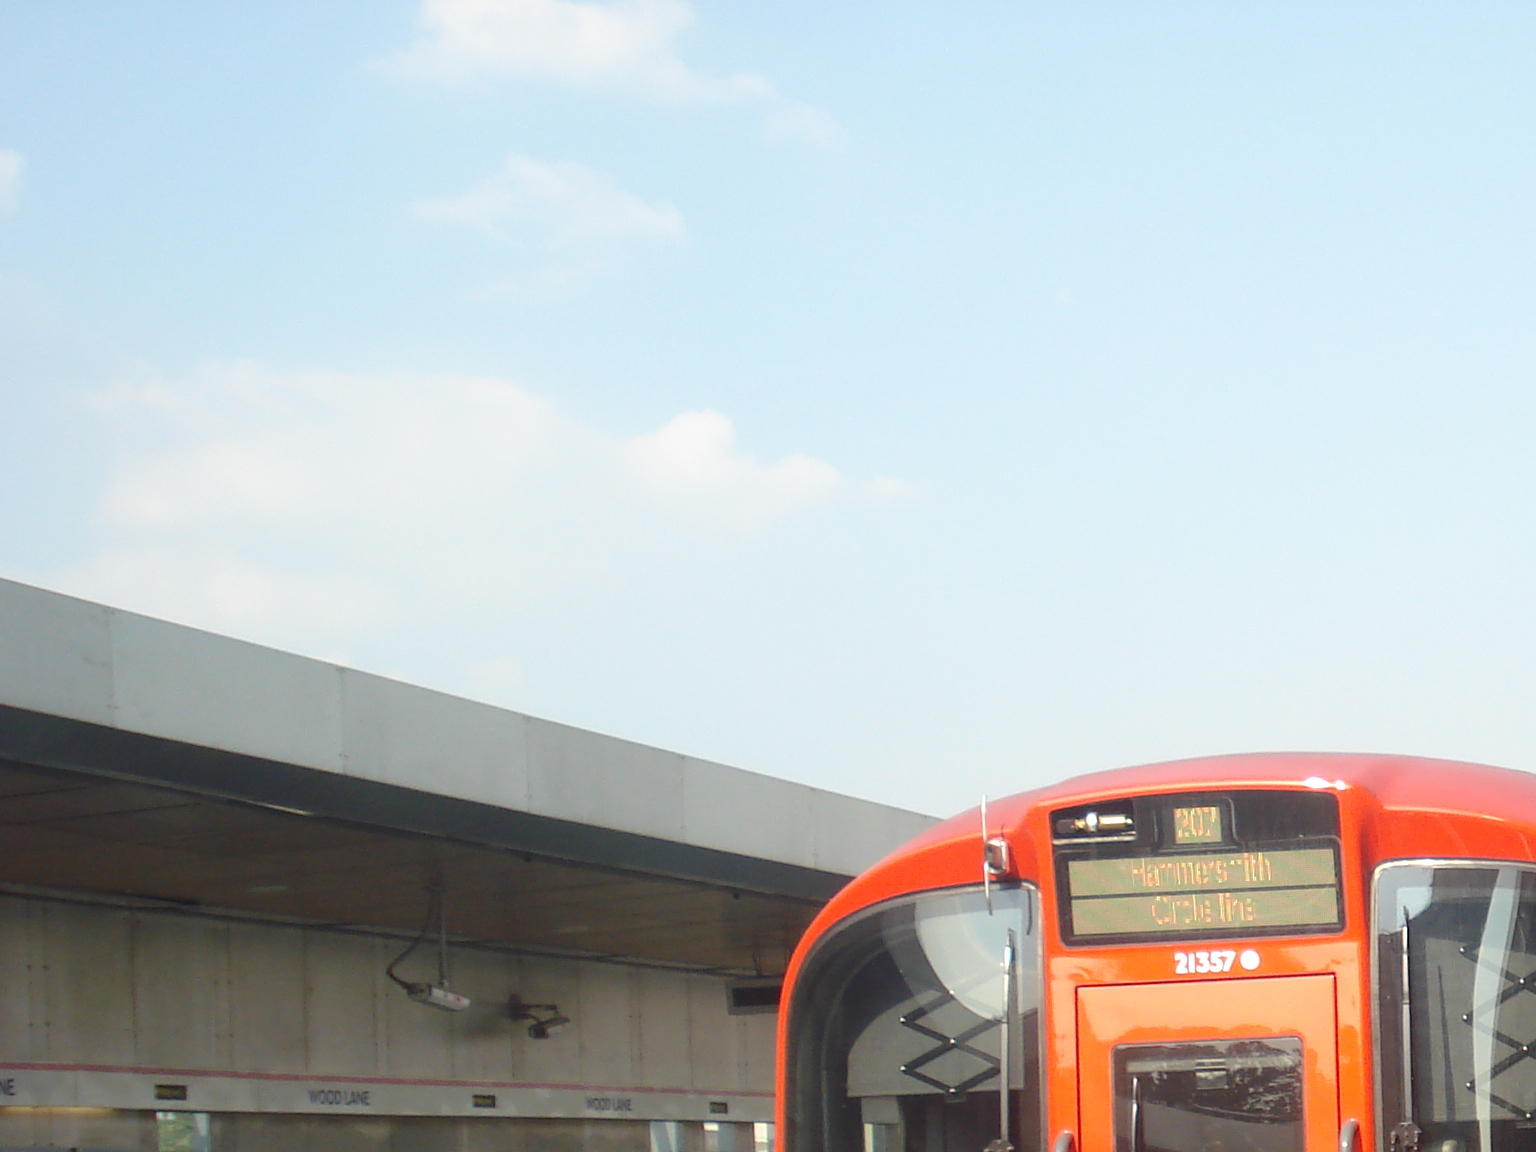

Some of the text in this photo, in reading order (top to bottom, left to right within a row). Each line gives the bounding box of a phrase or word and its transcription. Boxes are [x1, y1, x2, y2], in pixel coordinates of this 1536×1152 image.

[1174, 950, 1236, 974] 21357
[308, 1089, 370, 1106] WOOD LANE
